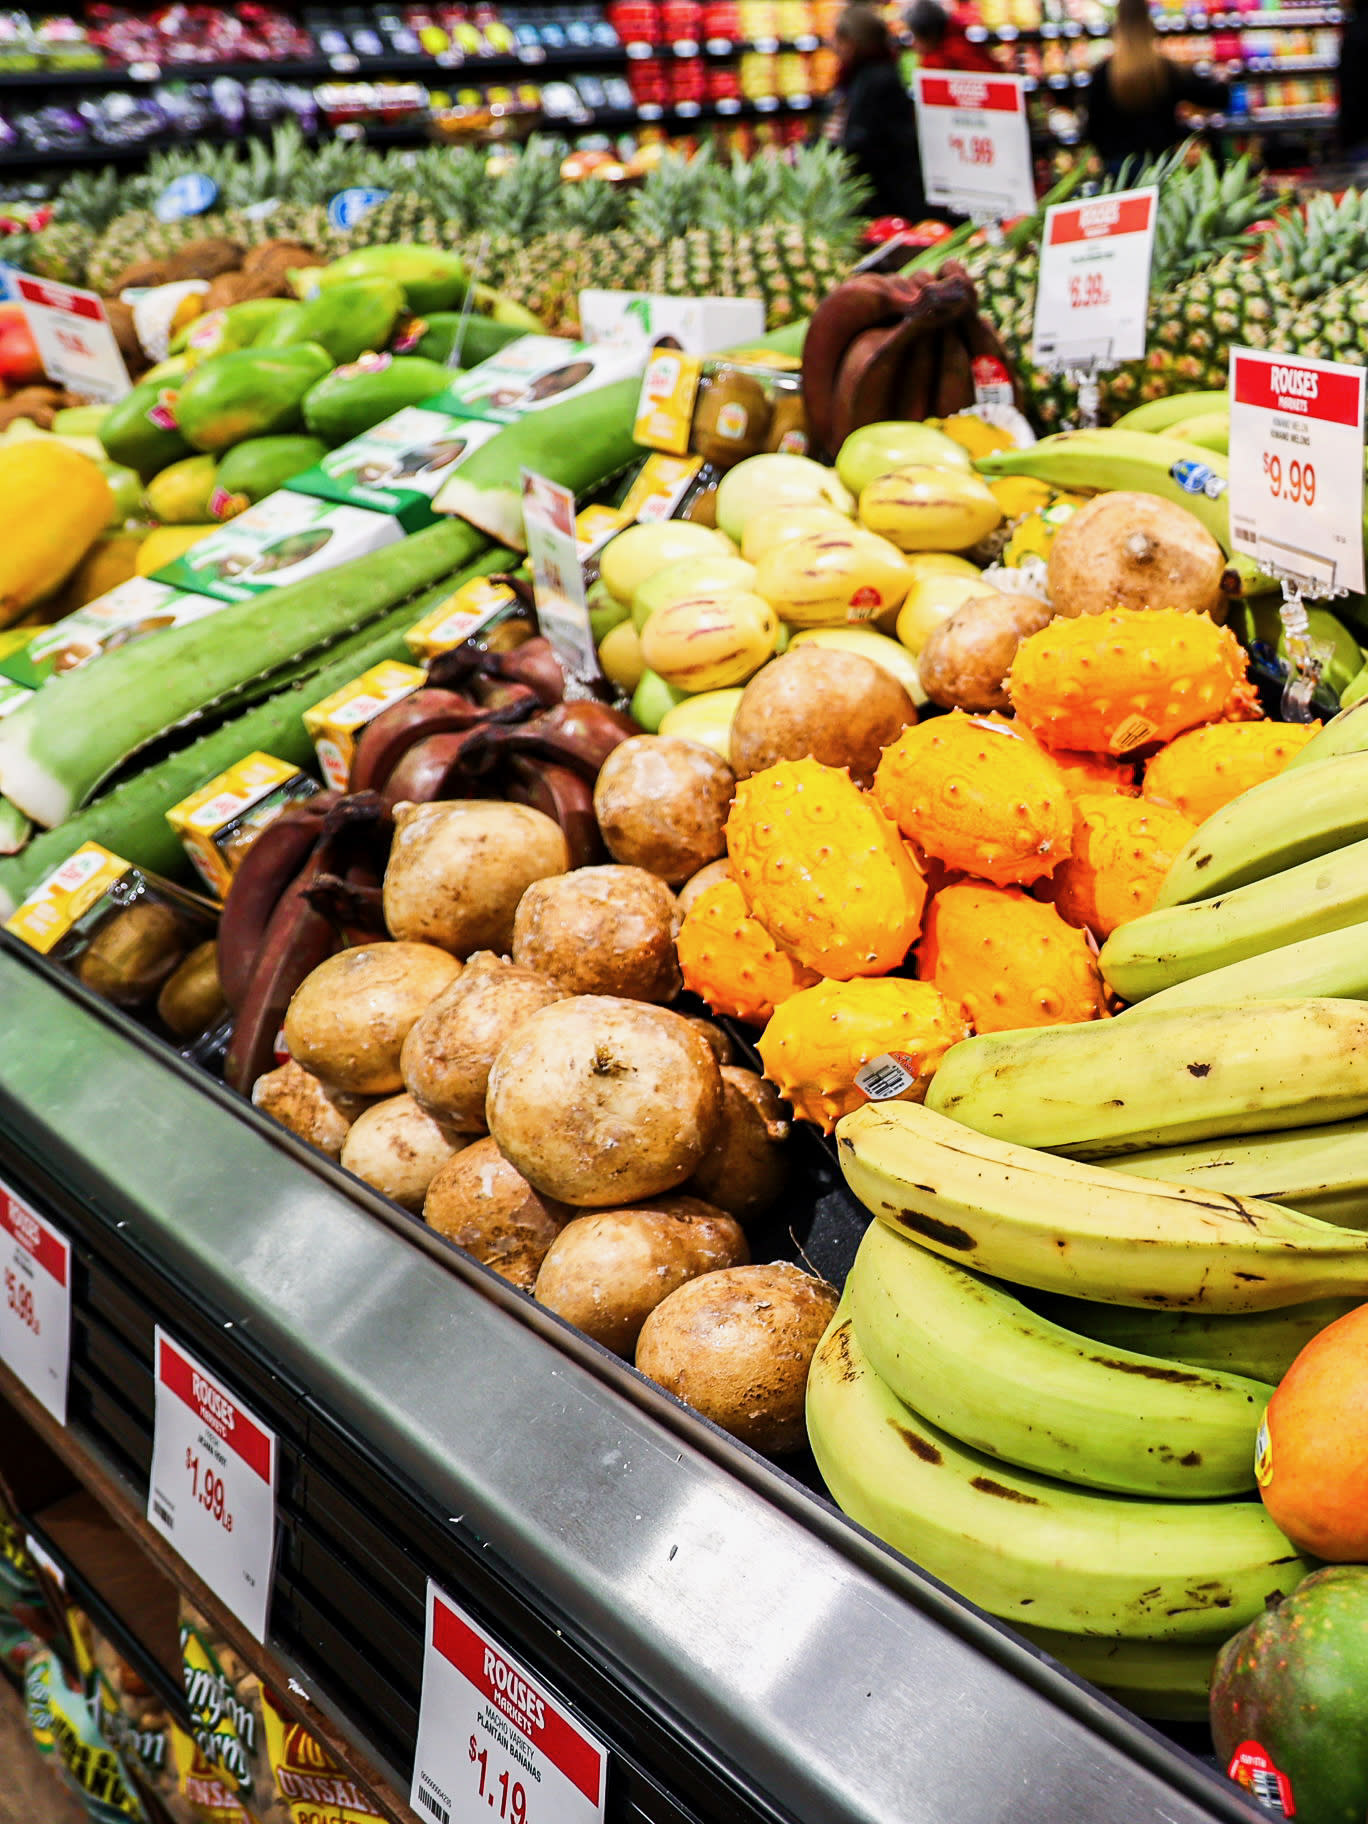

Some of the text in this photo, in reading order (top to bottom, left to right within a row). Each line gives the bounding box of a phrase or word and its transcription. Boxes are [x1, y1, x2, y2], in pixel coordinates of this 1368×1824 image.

[1270, 365, 1318, 399] ROUSES
[1263, 452, 1316, 506] $9.99
[192, 1371, 236, 1431] ROUSES
[483, 1647, 545, 1730] ROUSES
[493, 1689, 533, 1736] MARKETS
[477, 1713, 541, 1783] PLANTAIN BANANAS
[485, 1705, 535, 1759] MACHO VARIETY
